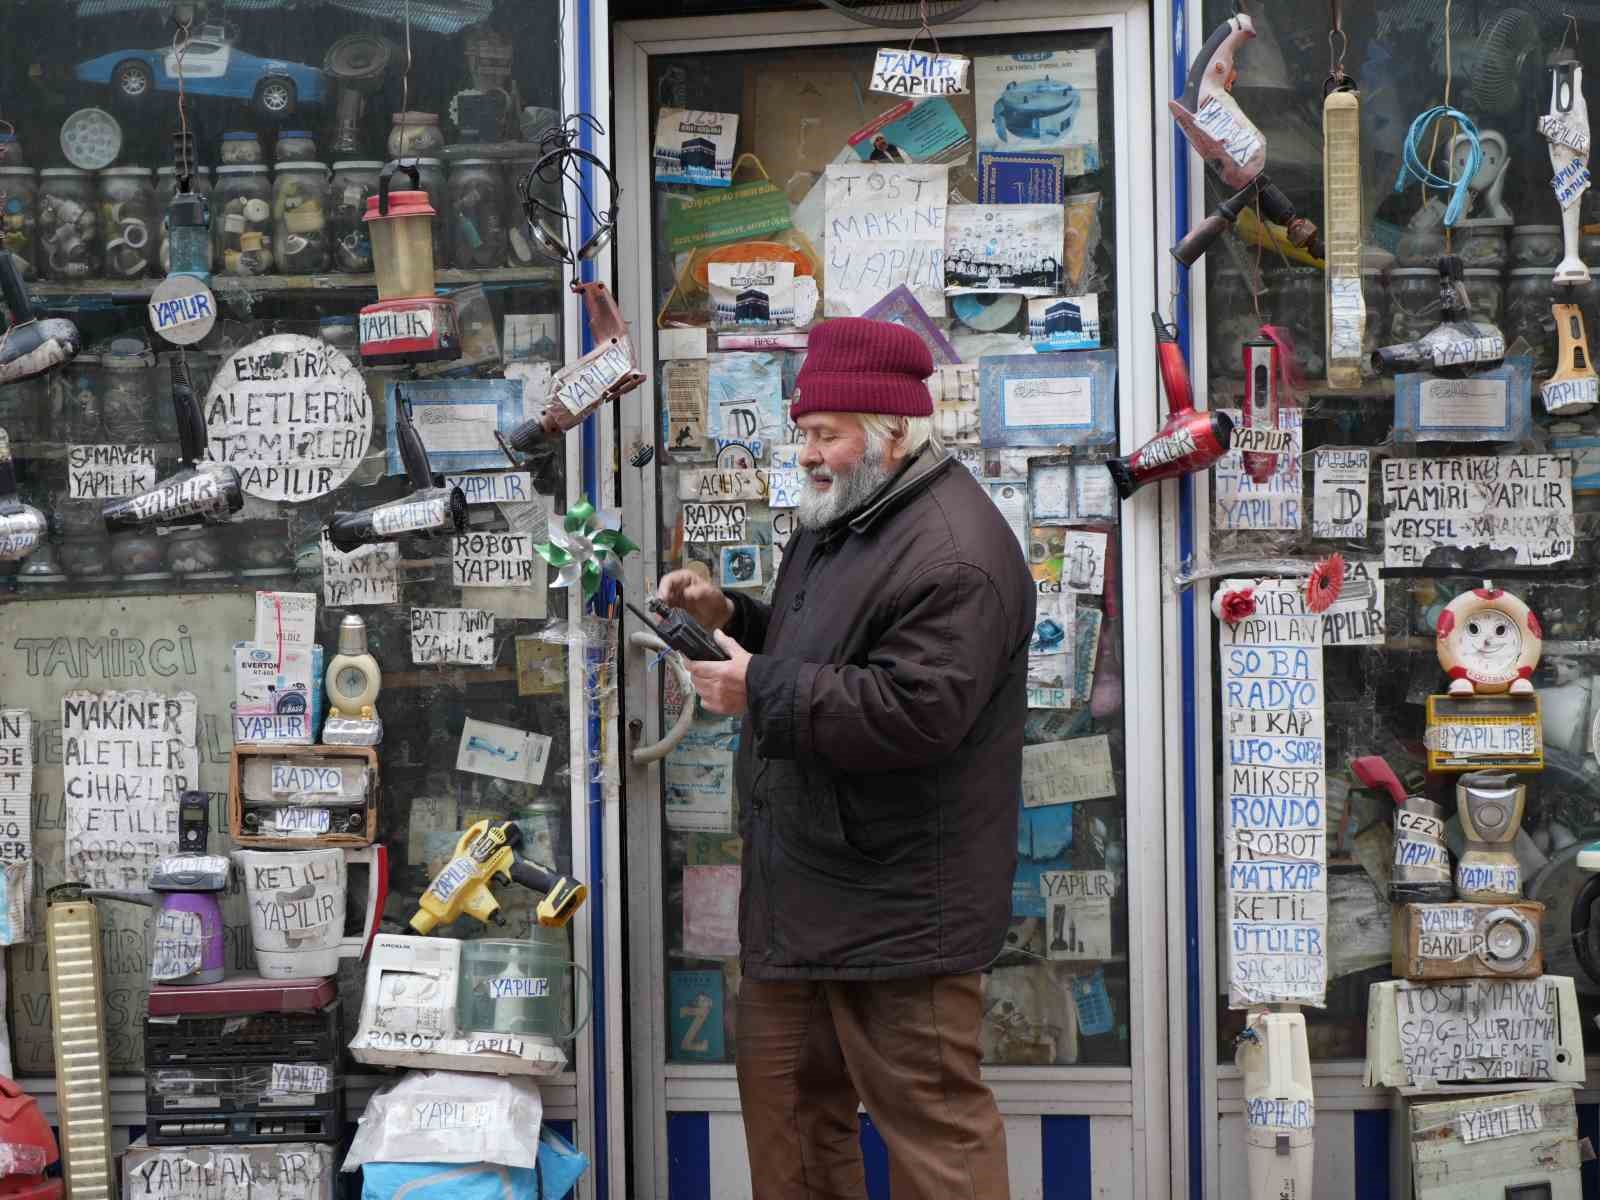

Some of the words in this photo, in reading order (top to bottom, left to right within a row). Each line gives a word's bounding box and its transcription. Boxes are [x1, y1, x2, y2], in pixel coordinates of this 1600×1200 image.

[837, 171, 930, 202] TOST
[152, 294, 209, 328] YAPILIR
[1233, 428, 1292, 450] YAPILIR
[1509, 457, 1570, 480] ALET
[1487, 482, 1565, 508] YAPILIR
[685, 503, 745, 525] RADYO
[1219, 499, 1298, 528] YAPILIR
[455, 536, 526, 556] ROBOT
[455, 559, 532, 583] YAPILIR
[1227, 619, 1318, 644] YAPILAN
[14, 625, 197, 678] TAMİRCİ
[1227, 680, 1316, 709] RADYO
[64, 700, 182, 734] MAKİNER
[239, 717, 303, 740] YAPILIR
[1451, 727, 1520, 749] YAPILIR
[66, 738, 184, 769] ALETLER
[67, 771, 188, 802] CİHAZLAR
[273, 769, 341, 790] RADYO
[1233, 766, 1320, 797] MİKSER
[278, 810, 330, 828] YAPILIR
[1231, 797, 1320, 828] RONDO
[1236, 829, 1322, 860] ROBOT
[1042, 874, 1109, 897] YAPILIR
[1230, 864, 1321, 891] MATKAP
[257, 894, 336, 930] YAPILIR
[1233, 895, 1313, 922] KETİL
[1234, 926, 1322, 955] ÜTÜLER
[1421, 935, 1484, 954] BAKILIR
